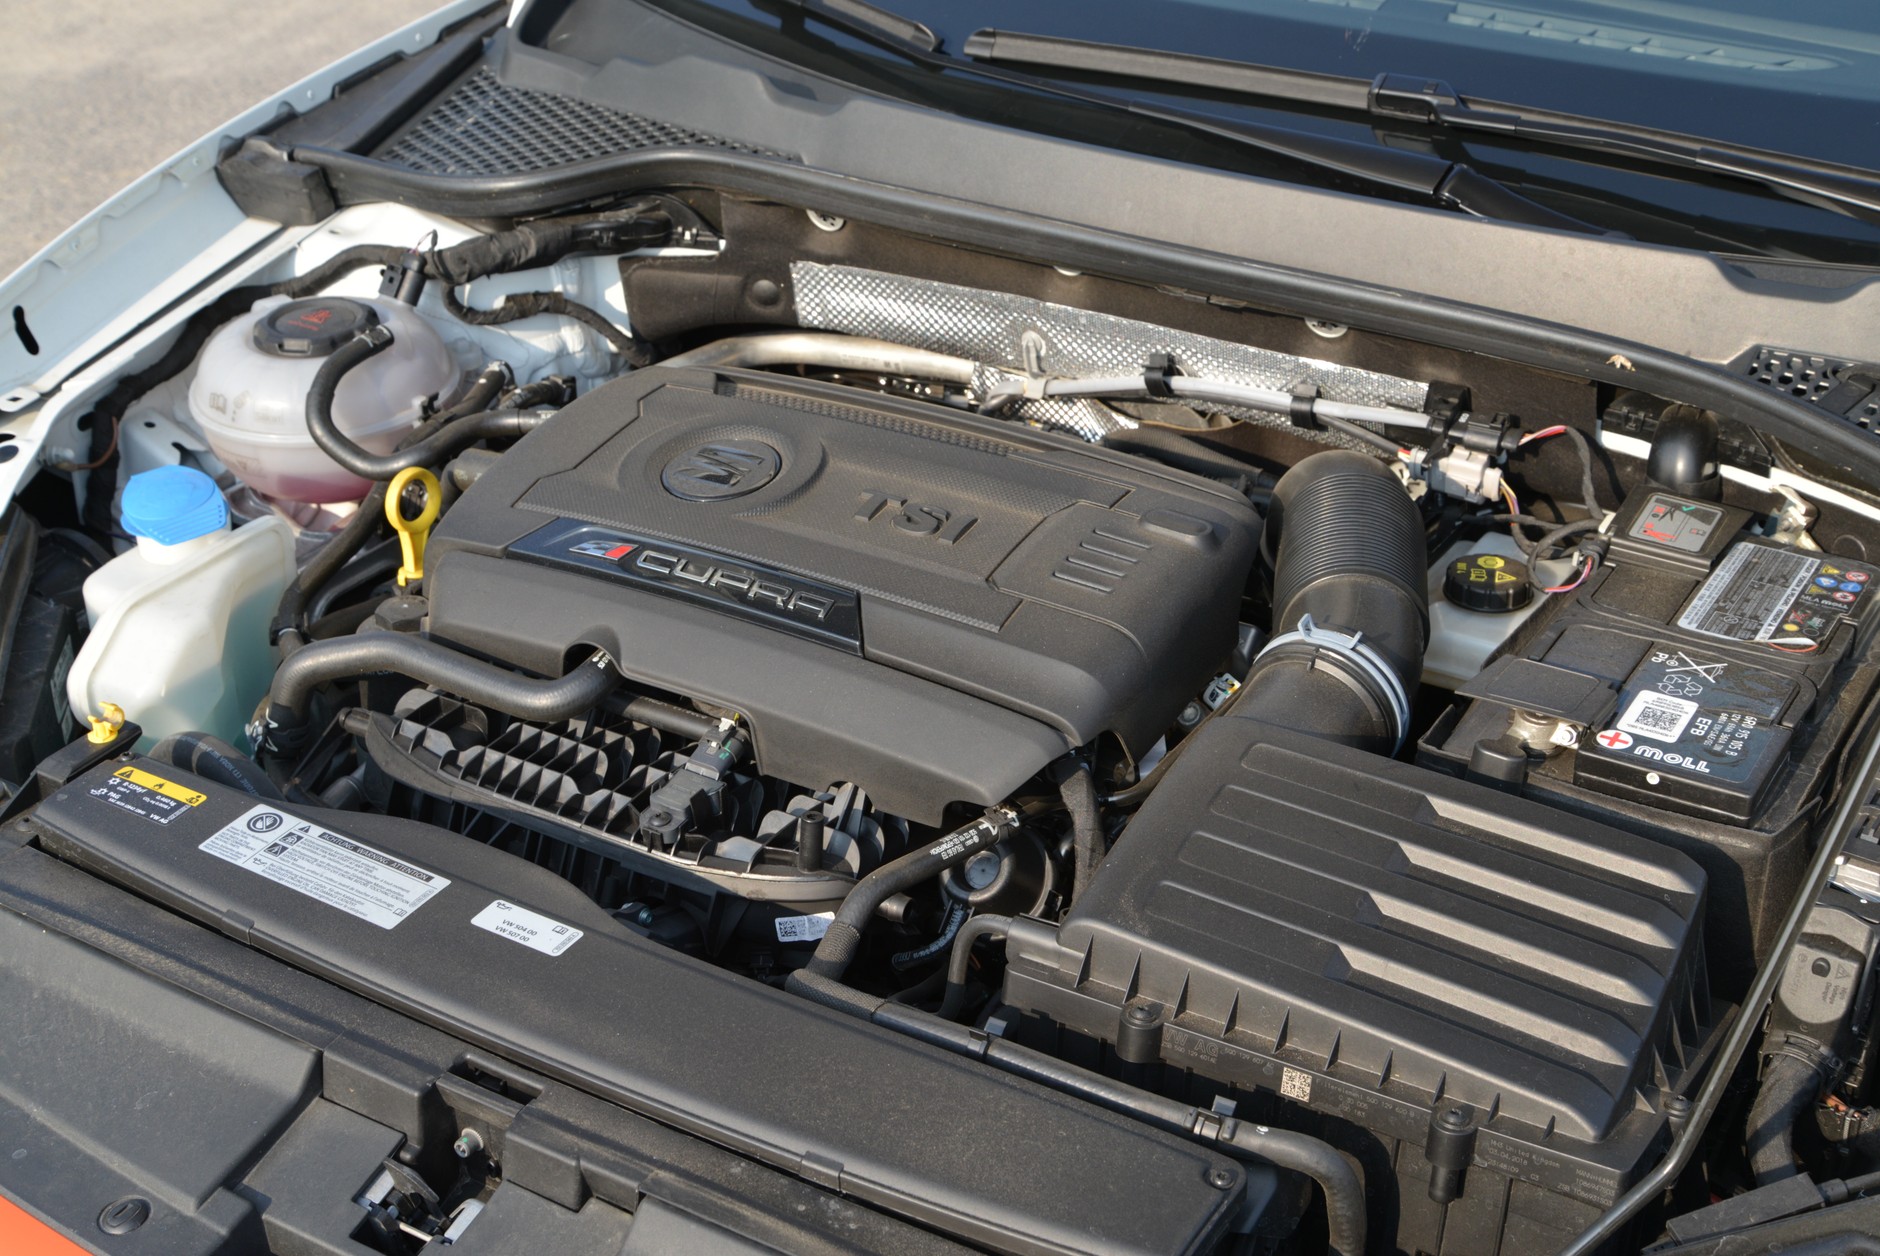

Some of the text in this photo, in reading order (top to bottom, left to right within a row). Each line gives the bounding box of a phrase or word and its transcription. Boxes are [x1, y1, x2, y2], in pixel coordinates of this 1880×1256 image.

[855, 489, 980, 545] TSI
[636, 550, 835, 621] CUPRA
[1651, 652, 1669, 663] Pb
[1690, 717, 1712, 736] EFB
[107, 791, 122, 799] PAG
[321, 834, 429, 880] ACHTUNG WARNING ATTENTION
[494, 925, 509, 933] VW
[506, 930, 521, 938] 507
[501, 919, 516, 927] VW
[513, 924, 528, 932] 504
[1161, 1027, 1221, 1058] VW AG
[1239, 1052, 1250, 1060] 129
[1505, 1145, 1530, 1158] United
